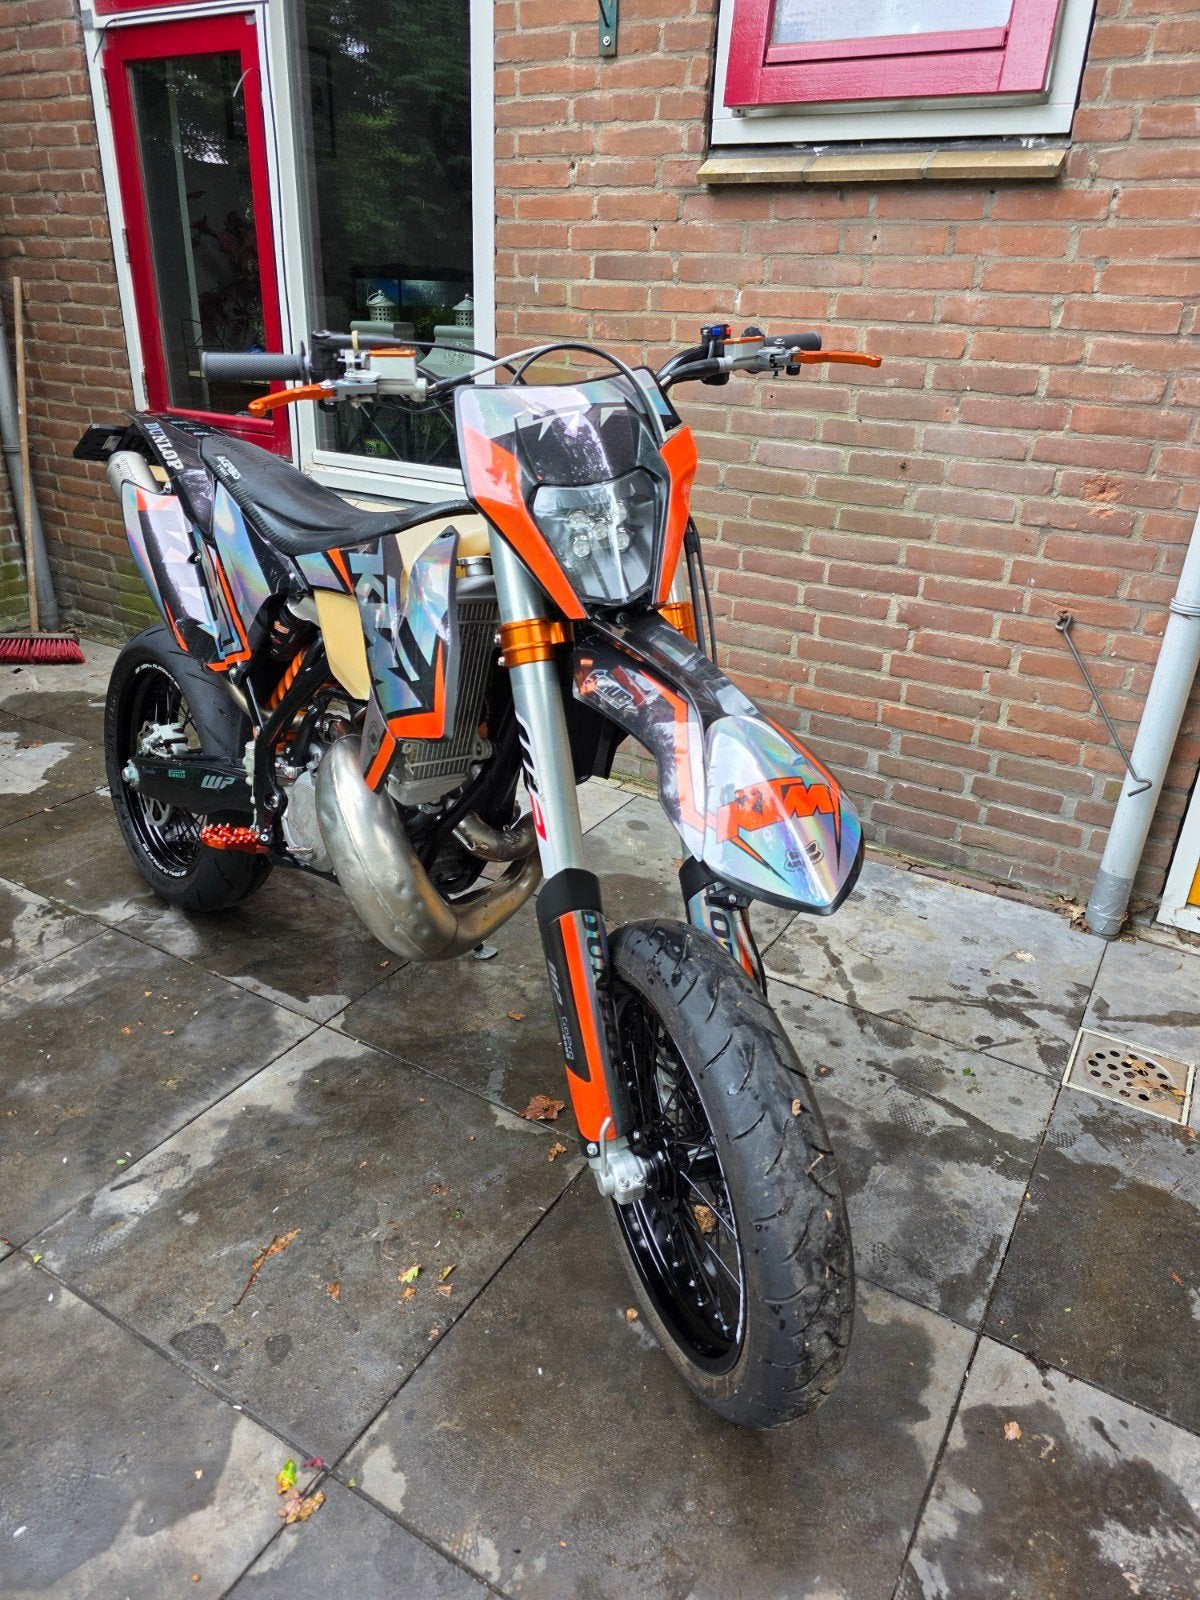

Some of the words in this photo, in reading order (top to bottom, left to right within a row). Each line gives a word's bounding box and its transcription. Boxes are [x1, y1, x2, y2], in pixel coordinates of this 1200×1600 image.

[144, 422, 184, 470] DUNLOP
[201, 775, 236, 790] WP
[716, 776, 836, 845] KTM
